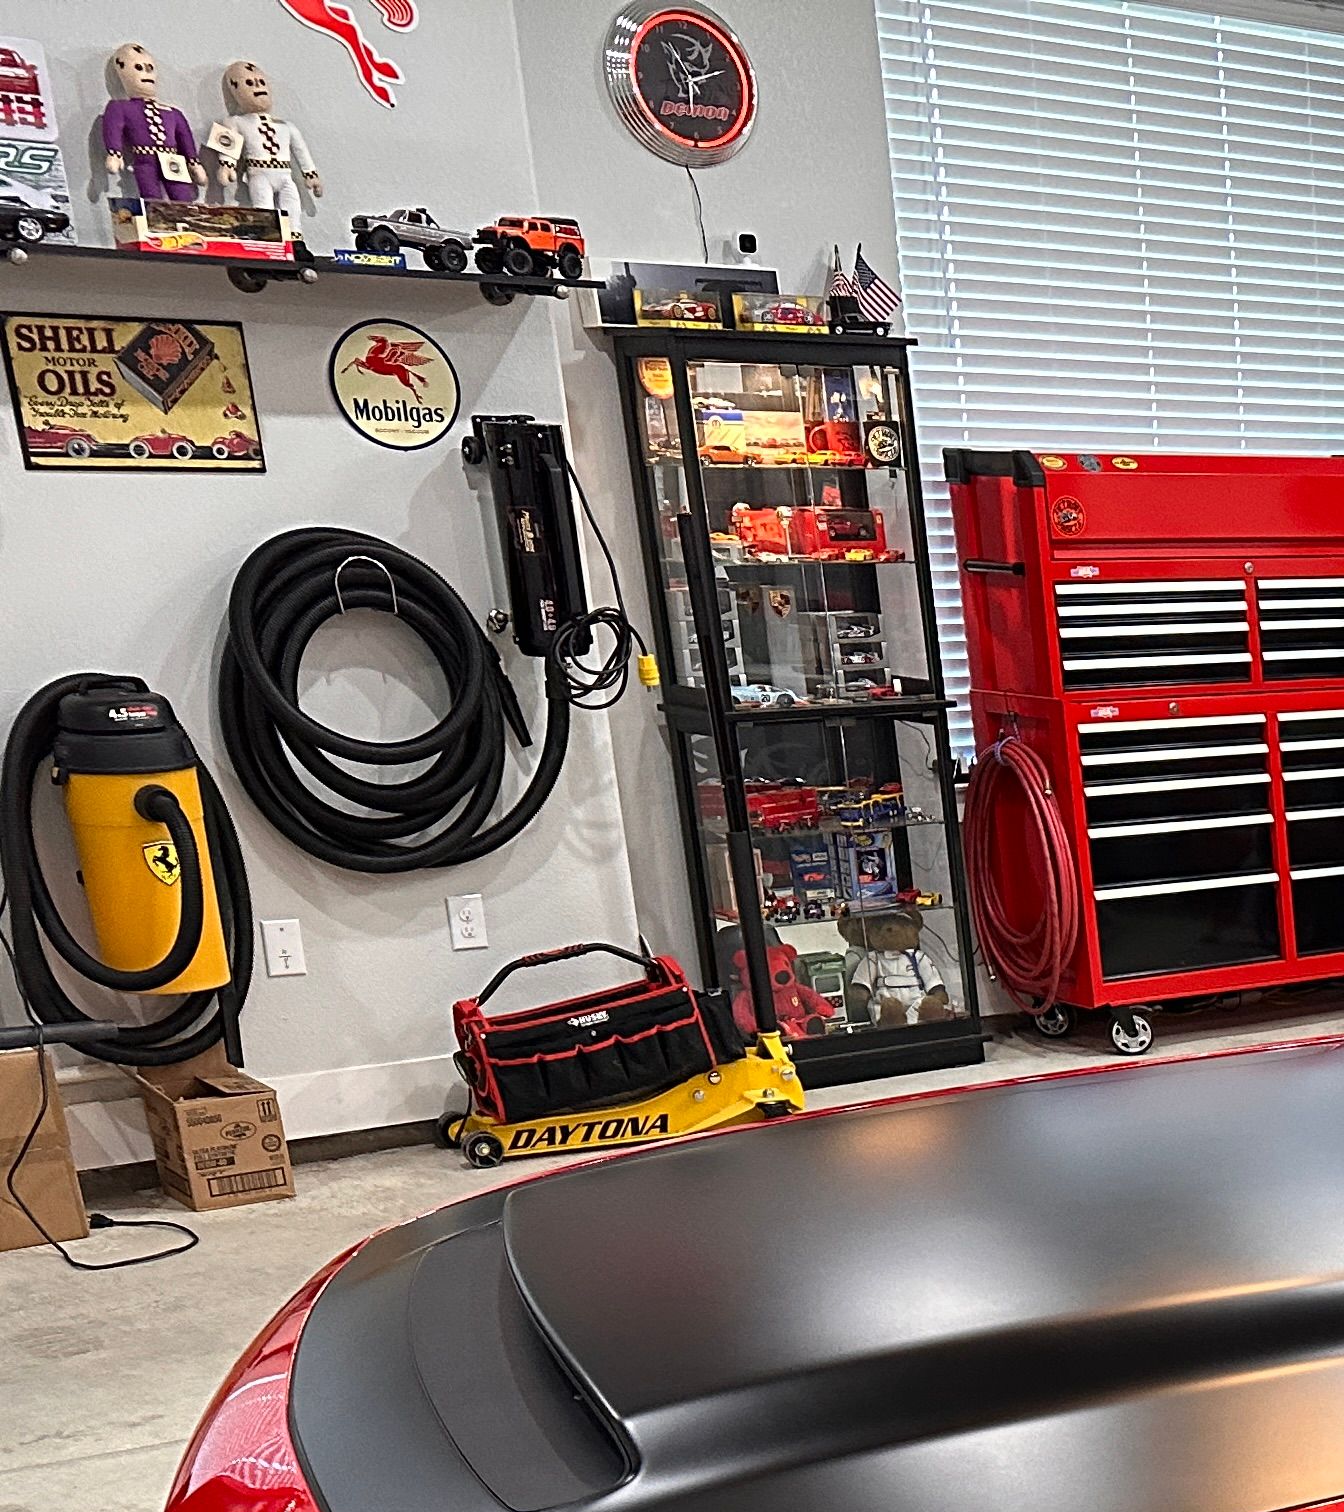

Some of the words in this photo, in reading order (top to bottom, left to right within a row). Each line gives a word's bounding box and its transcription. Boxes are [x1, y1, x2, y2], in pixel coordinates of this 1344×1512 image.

[14, 324, 125, 355] SHELL
[44, 356, 98, 367] MOTOR
[37, 370, 117, 397] OILS
[353, 397, 445, 428] Mobilgas
[507, 1113, 669, 1151] DAYTONA
